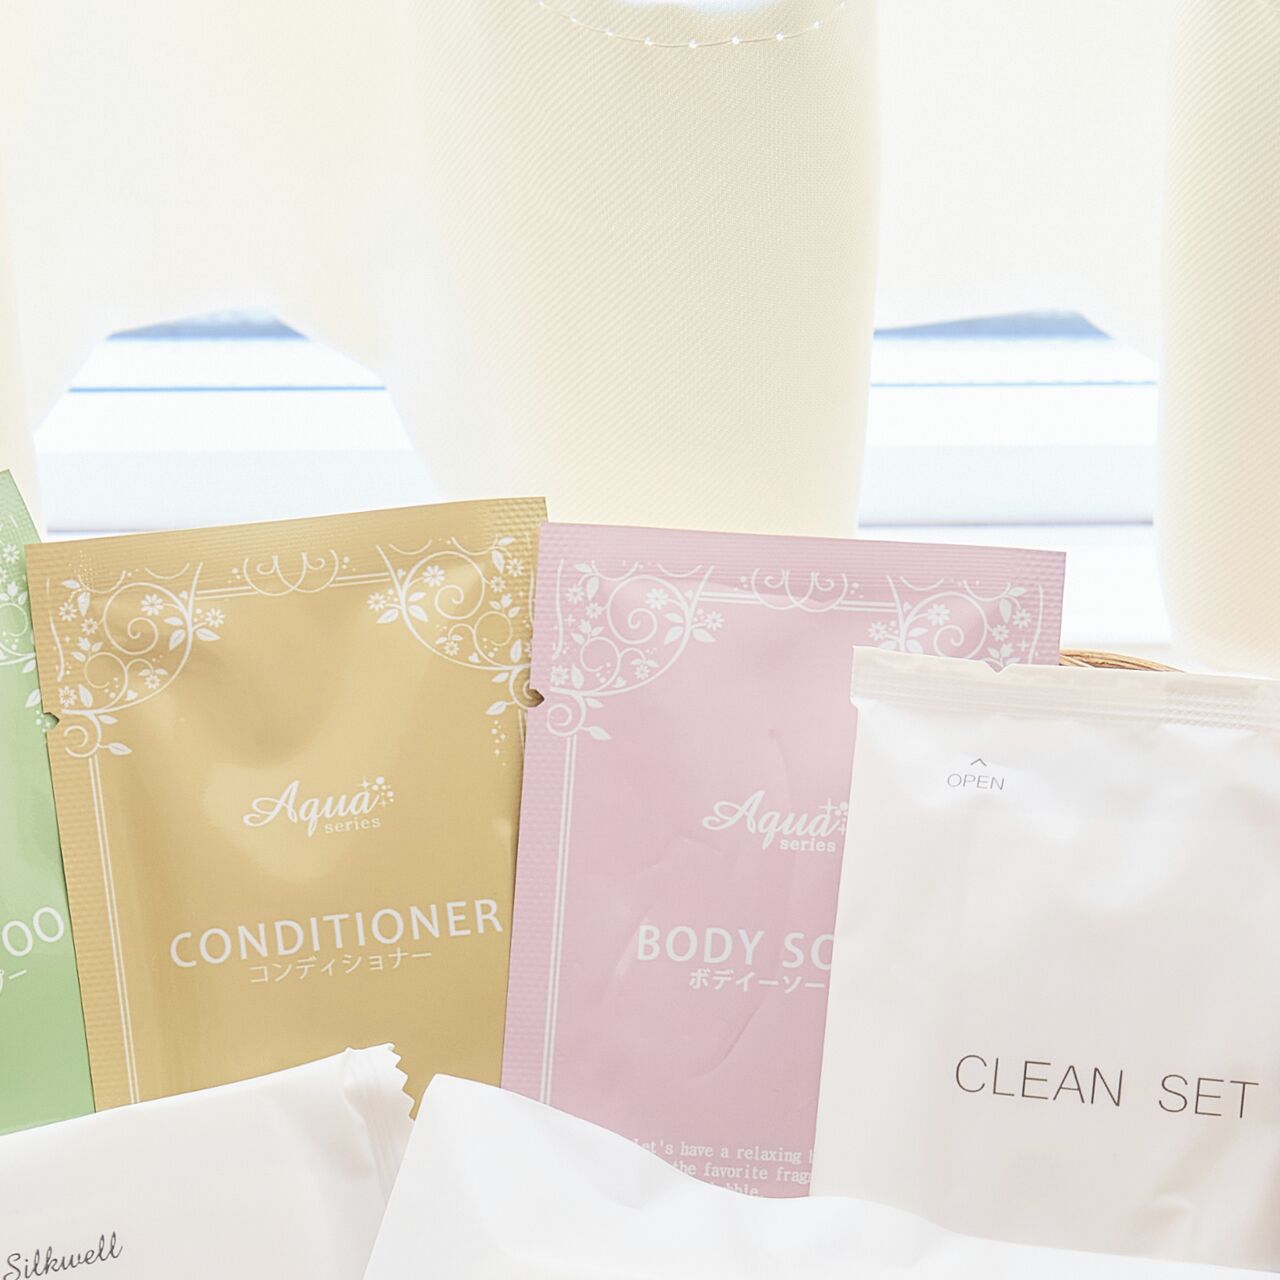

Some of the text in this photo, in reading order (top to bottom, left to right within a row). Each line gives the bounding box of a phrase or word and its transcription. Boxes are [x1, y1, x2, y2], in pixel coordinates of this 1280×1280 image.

[946, 772, 1005, 791] OPEN
[243, 779, 380, 838] Aqua
[324, 815, 383, 834] series
[702, 789, 840, 851] Aqua
[779, 837, 837, 853] series
[169, 898, 504, 968] CONDITIONER
[636, 924, 766, 966] BODY
[248, 946, 433, 984] コンディショナー
[954, 1053, 1260, 1119] CLEAN SET
[634, 1138, 674, 1156] et's
[680, 1140, 714, 1157] have
[720, 1146, 729, 1158] a
[736, 1145, 803, 1165] relaxing
[703, 1162, 769, 1180] favorite
